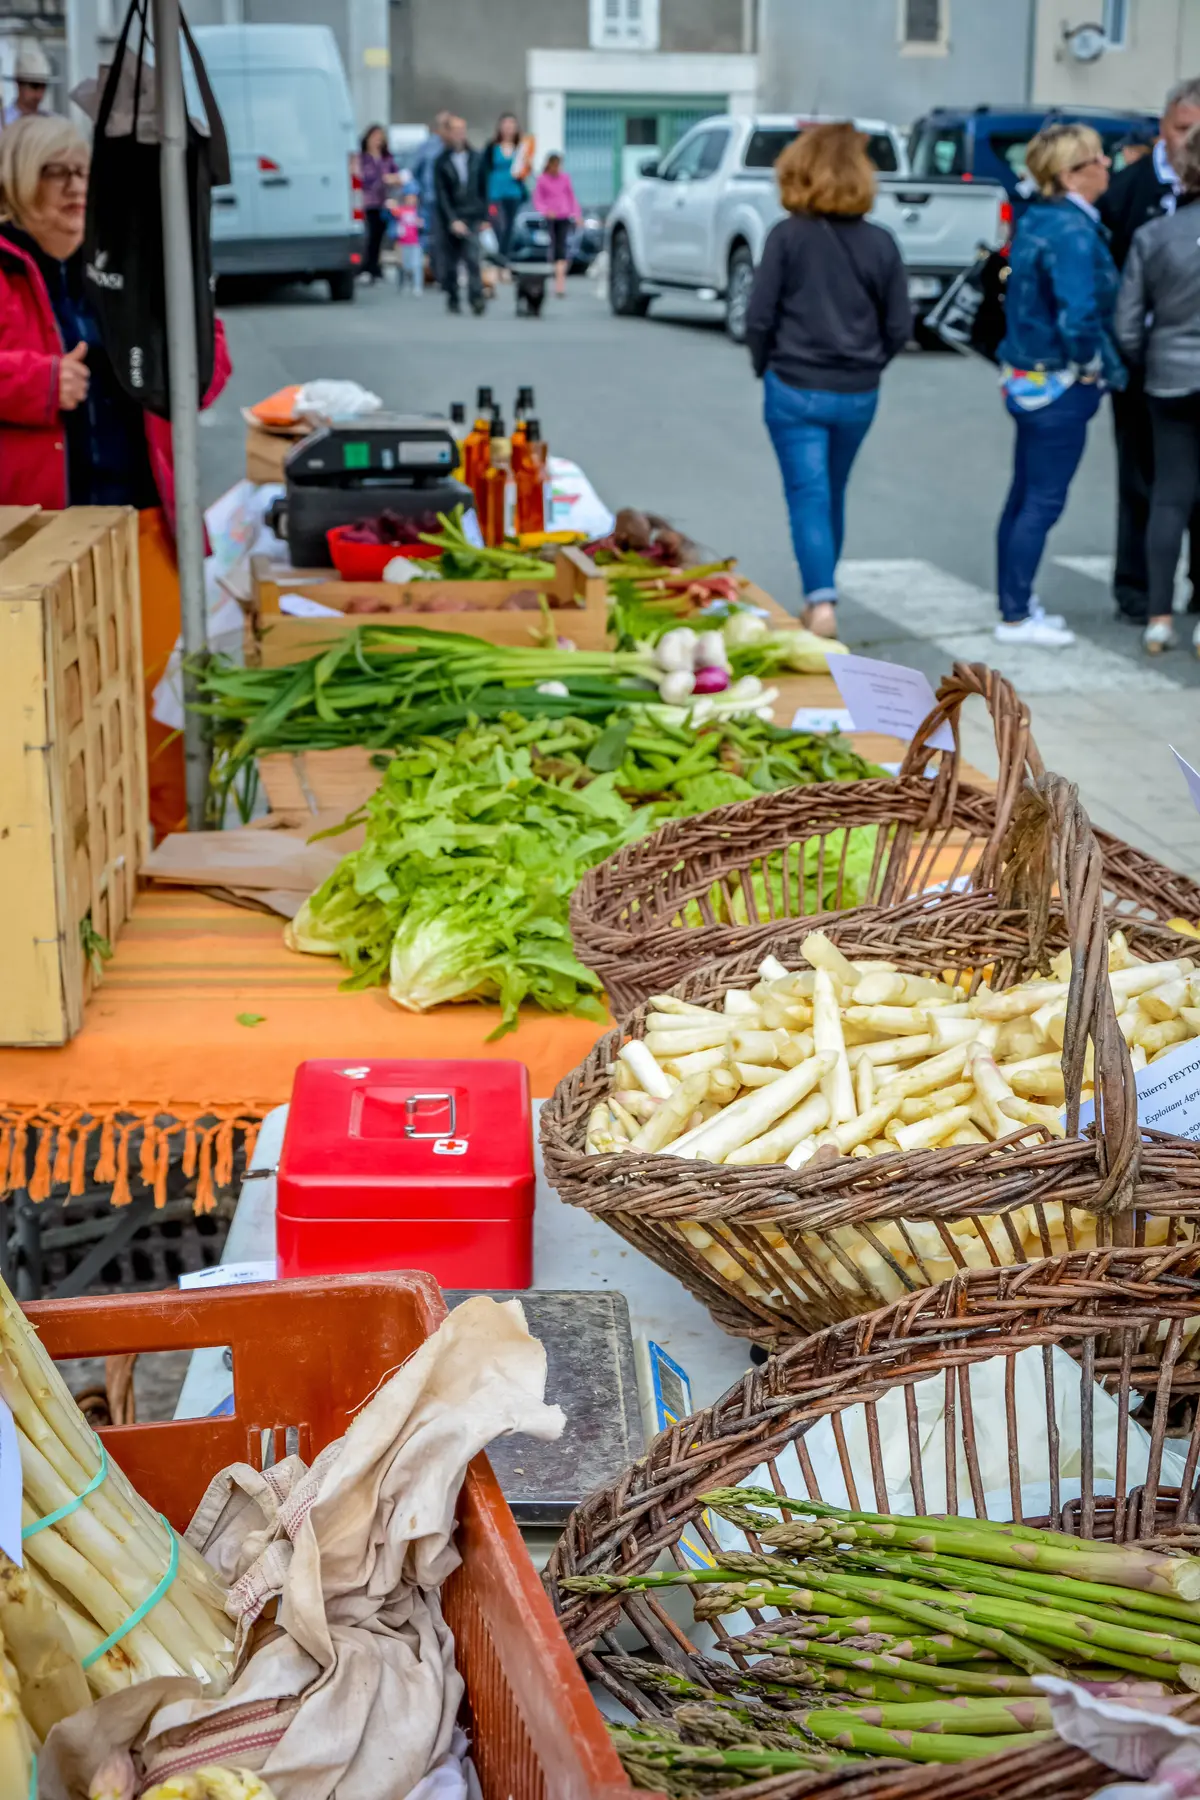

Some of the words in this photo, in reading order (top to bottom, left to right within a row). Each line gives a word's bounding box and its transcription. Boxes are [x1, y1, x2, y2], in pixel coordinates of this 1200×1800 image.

[1137, 1080, 1167, 1100] Thierry
[1145, 1099, 1183, 1124] Exploitant
[1184, 1088, 1200, 1104] Agri
